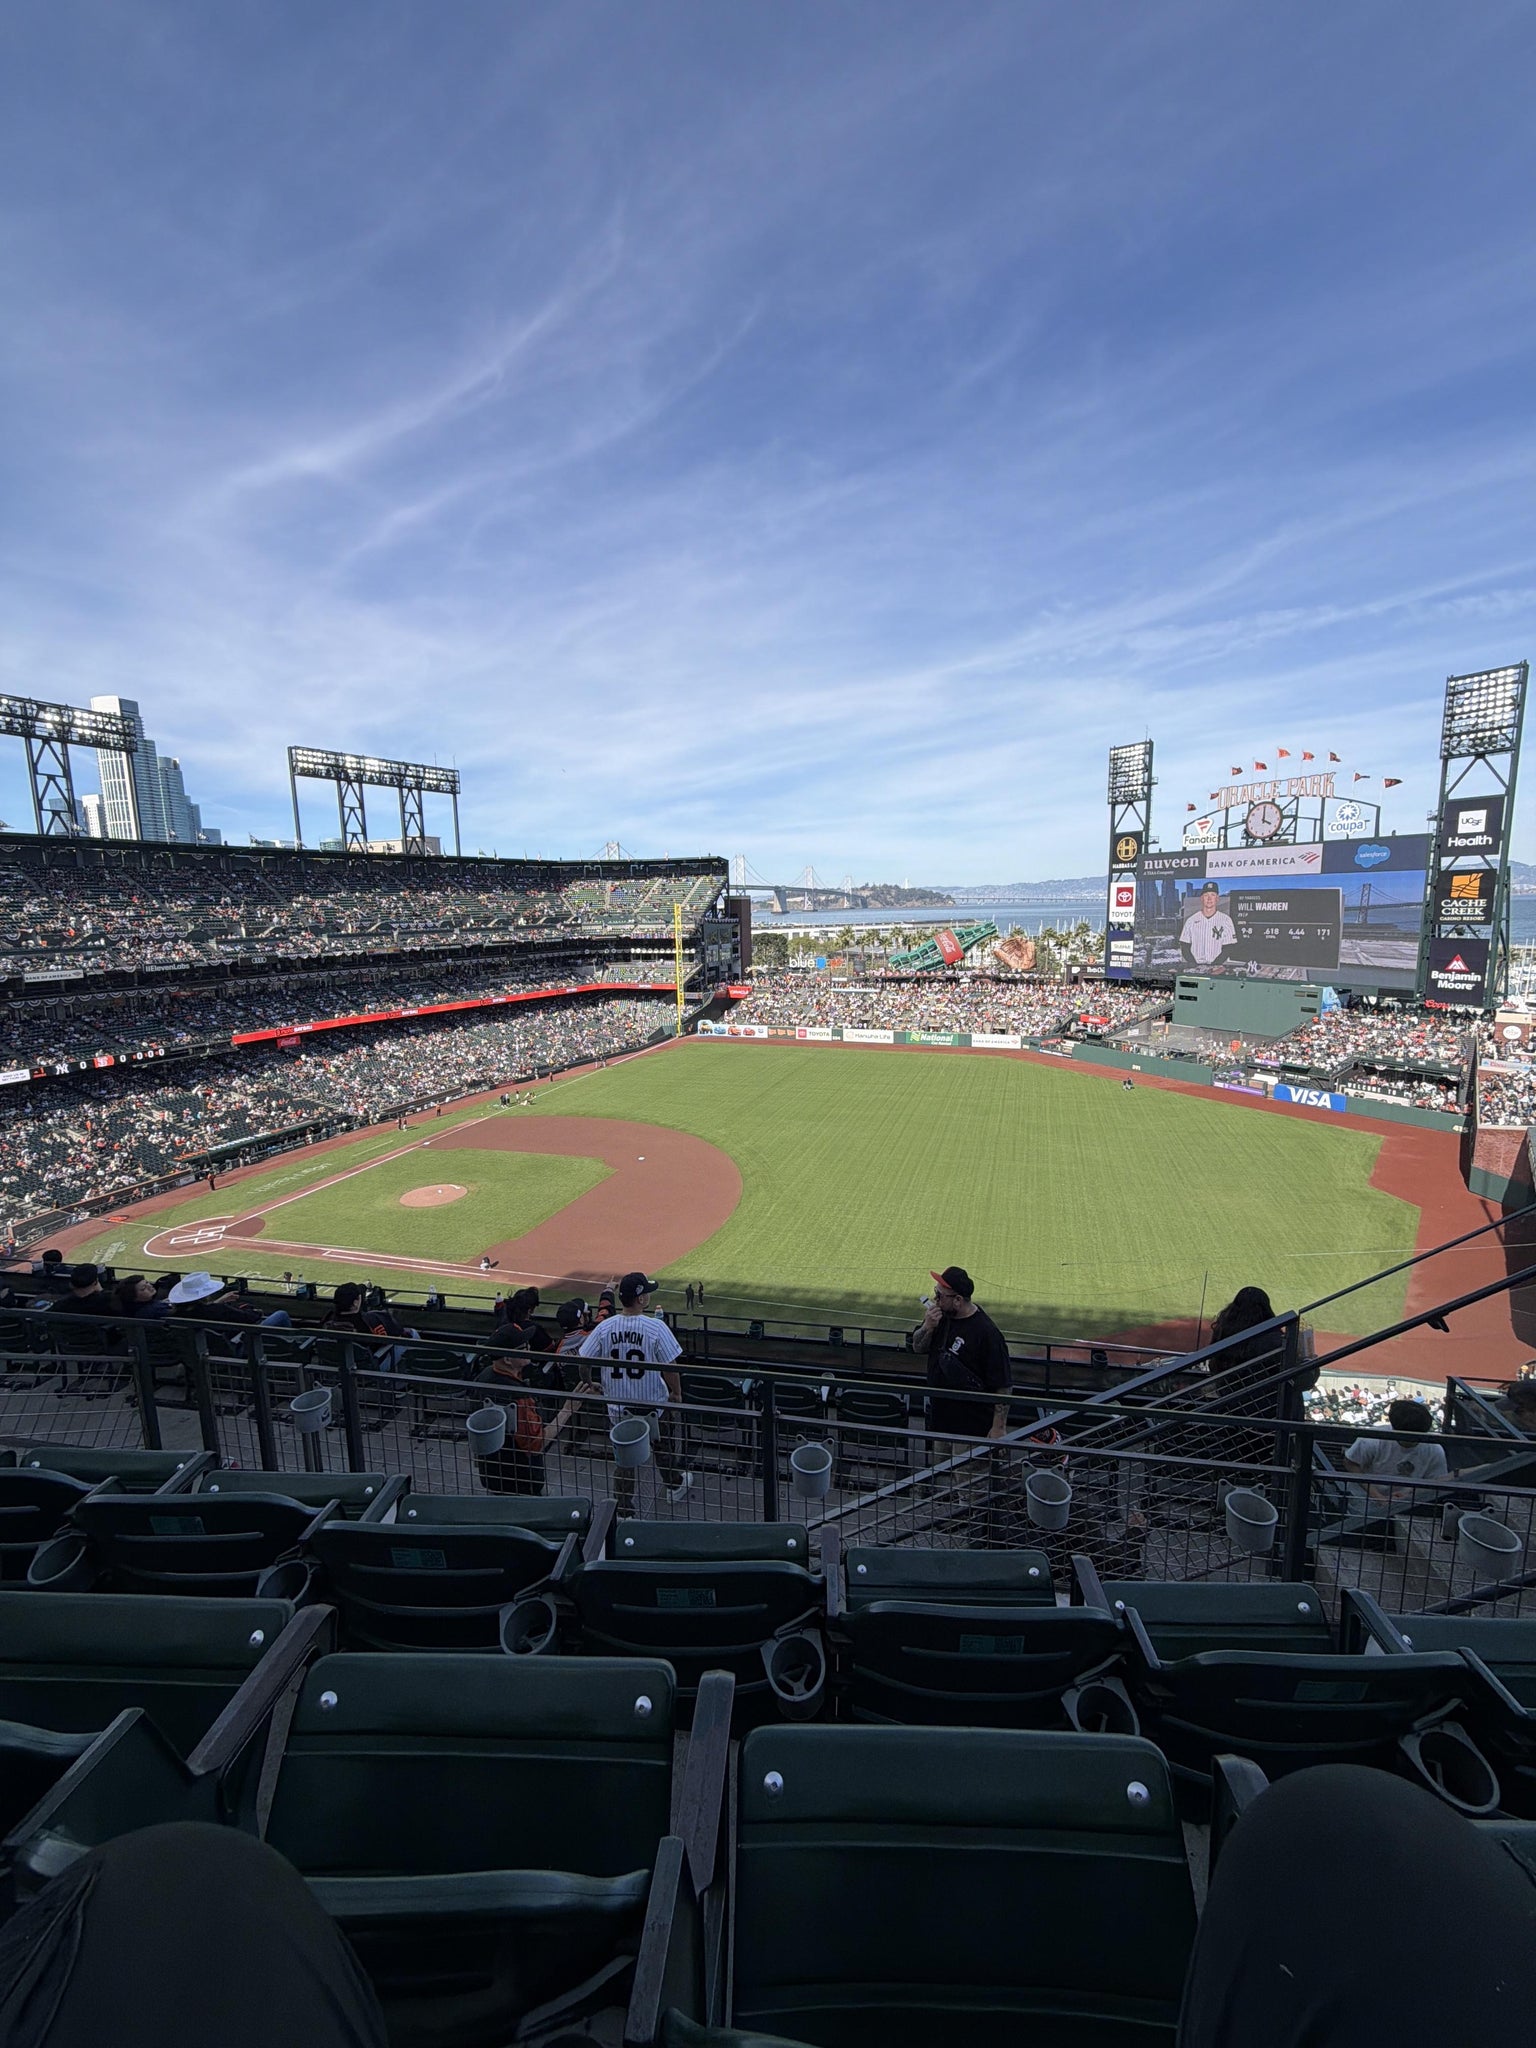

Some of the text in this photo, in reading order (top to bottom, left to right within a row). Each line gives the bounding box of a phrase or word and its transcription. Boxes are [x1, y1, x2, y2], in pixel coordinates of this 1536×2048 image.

[1217, 771, 1337, 810] ORACLE PARK
[1330, 821, 1363, 832] coupa
[1461, 817, 1483, 826] UCSF
[1447, 834, 1493, 847] Health
[1143, 857, 1200, 869] nuveen
[1208, 857, 1296, 869] BANK OF AMERICA
[1238, 902, 1288, 911] WILL WARREN
[1441, 898, 1487, 907] CACHE
[1441, 907, 1485, 915] CREEK
[1241, 927, 1253, 935] 9-8
[1263, 927, 1280, 935] .618
[1288, 928, 1305, 936] 4.44
[789, 956, 815, 968] blue
[1430, 970, 1482, 982] Benjamin
[1437, 980, 1473, 991] Moore
[921, 1033, 953, 1042] National
[80, 1061, 87, 1069] 0
[120, 1054, 126, 1062] 0
[1347, 1082, 1397, 1096] WELCOME TO
[1287, 1086, 1332, 1109] VISA
[610, 1331, 644, 1346] DAMON
